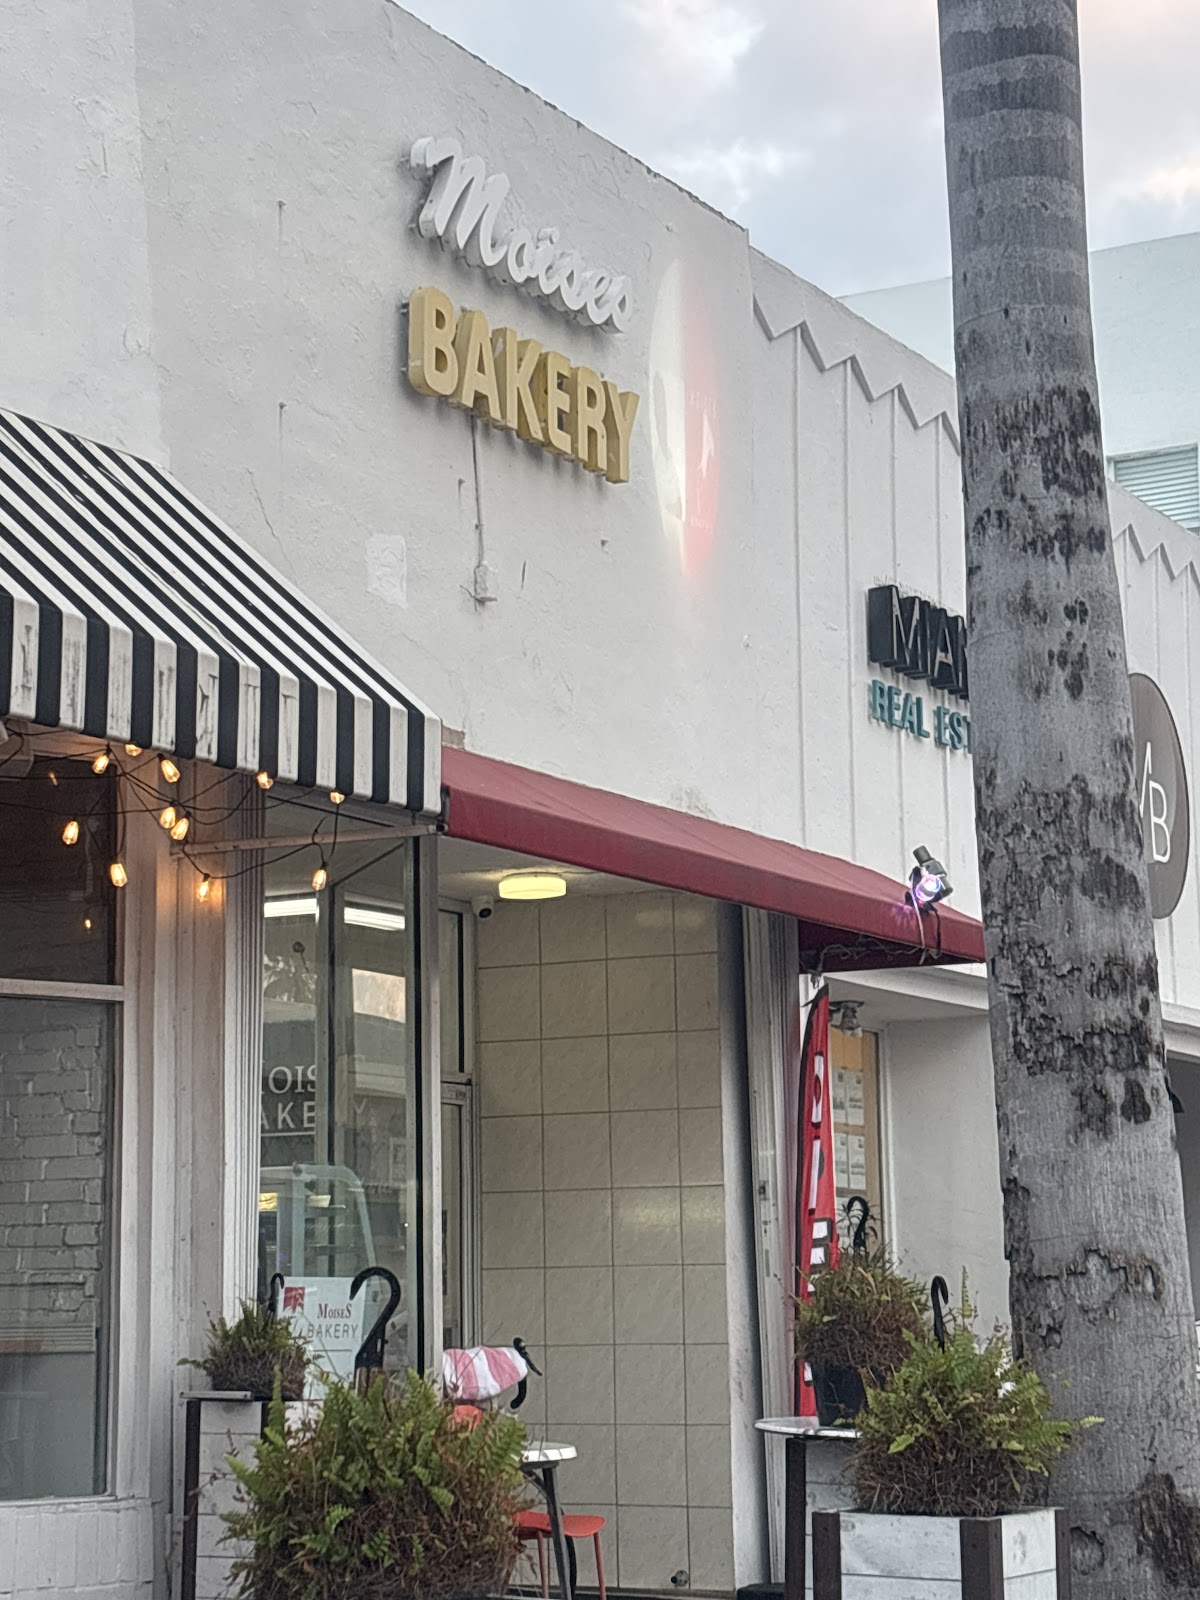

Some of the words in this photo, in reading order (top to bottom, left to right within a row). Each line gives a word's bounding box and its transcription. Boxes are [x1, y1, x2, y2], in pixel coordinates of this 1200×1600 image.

[409, 137, 633, 334] Moises
[407, 287, 641, 484] BAKERY
[871, 679, 930, 738] REAL
[307, 1323, 359, 1339] BAKERY
